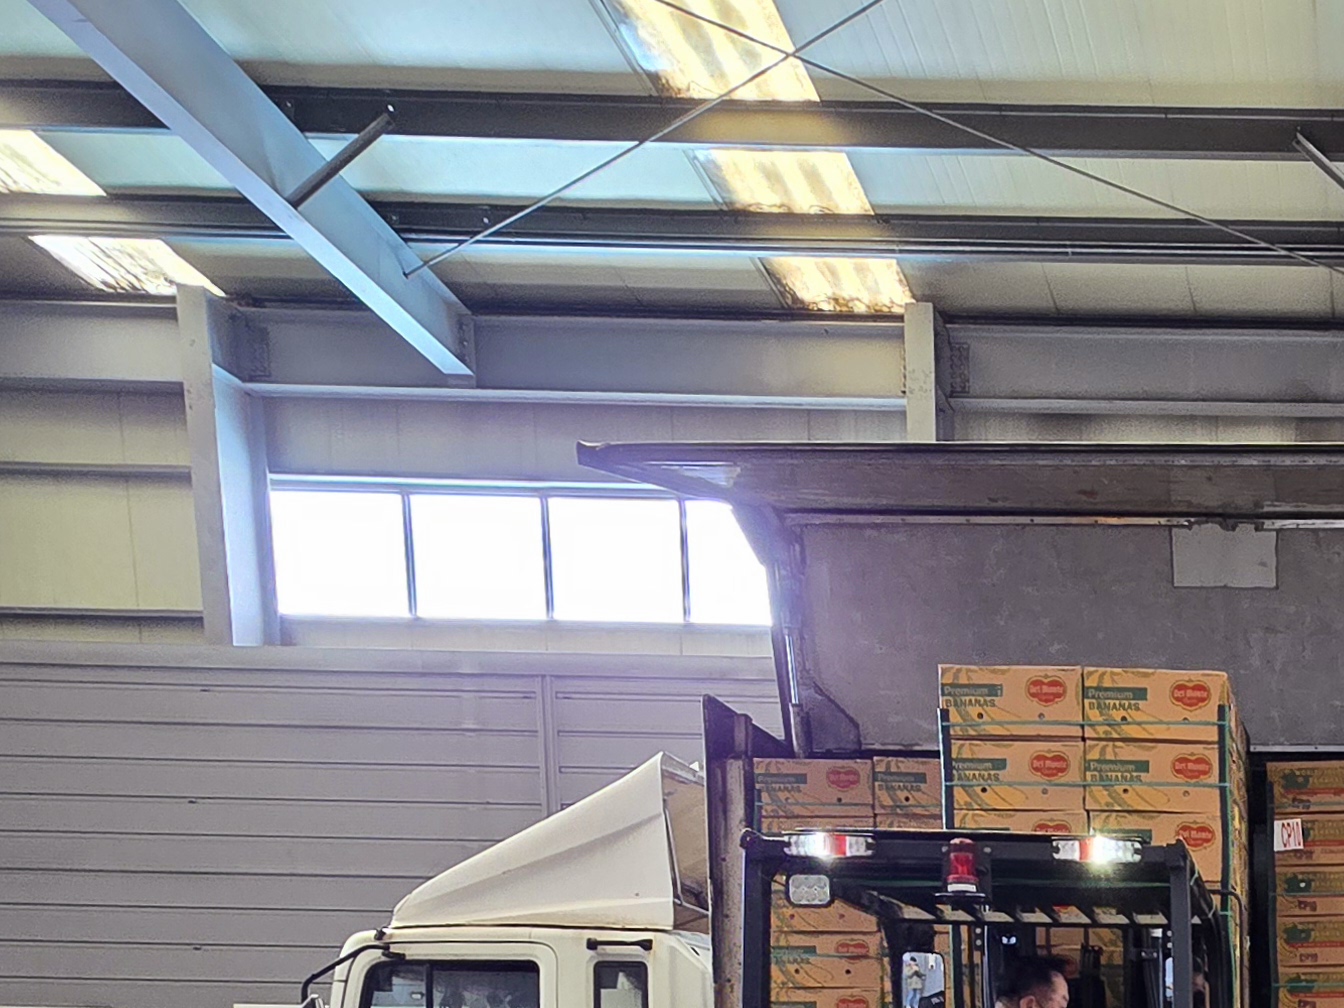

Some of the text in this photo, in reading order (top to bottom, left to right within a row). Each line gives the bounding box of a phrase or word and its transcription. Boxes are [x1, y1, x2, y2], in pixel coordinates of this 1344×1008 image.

[944, 686, 988, 696] Premium
[1088, 689, 1133, 698] Premium
[1173, 689, 1208, 698] Del Monte
[945, 699, 996, 708] BANANAS
[1089, 702, 1141, 711] BANANAS
[1090, 763, 1136, 772] Premium
[1174, 762, 1210, 771] Del Monte
[954, 773, 1000, 781] ANANAS
[1091, 775, 1143, 783] BANANAS
